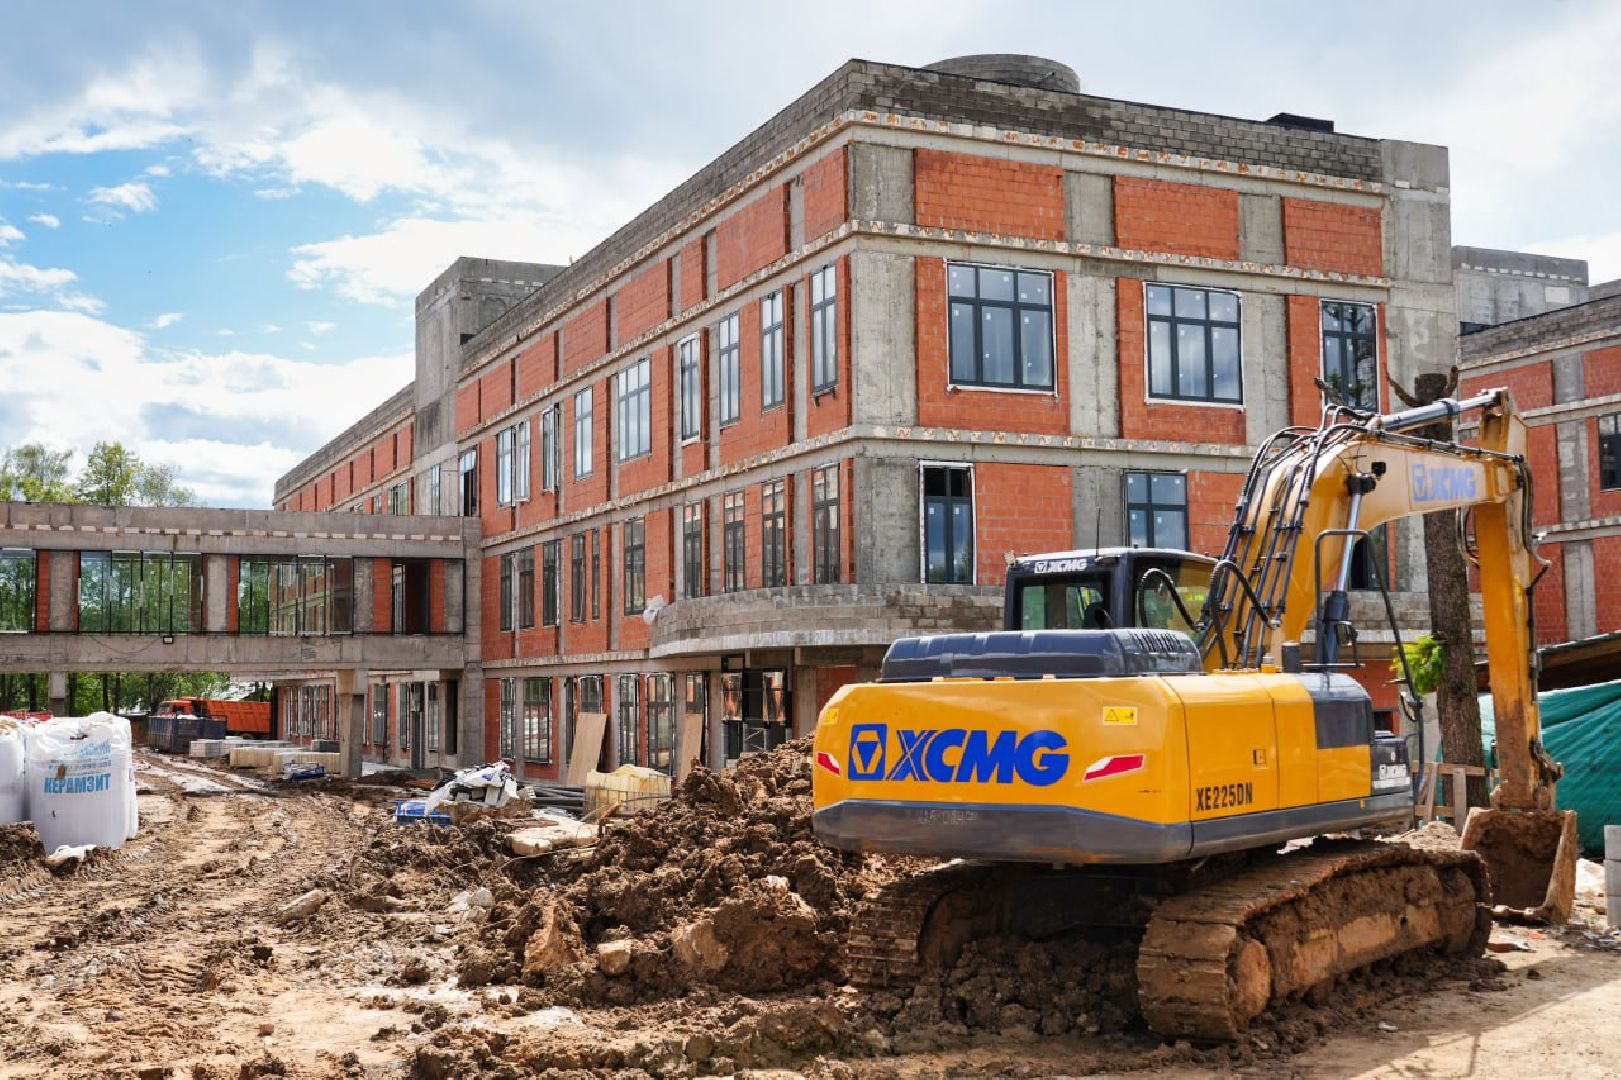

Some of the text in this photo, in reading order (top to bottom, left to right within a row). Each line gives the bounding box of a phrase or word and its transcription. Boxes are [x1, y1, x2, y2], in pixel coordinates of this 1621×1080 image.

[1431, 467, 1476, 500] XCMG
[1048, 559, 1087, 573] XCMG
[885, 729, 1070, 787] XCMG
[44, 773, 111, 793] КЕРАМЗИТ
[1196, 782, 1253, 812] XE225DN
